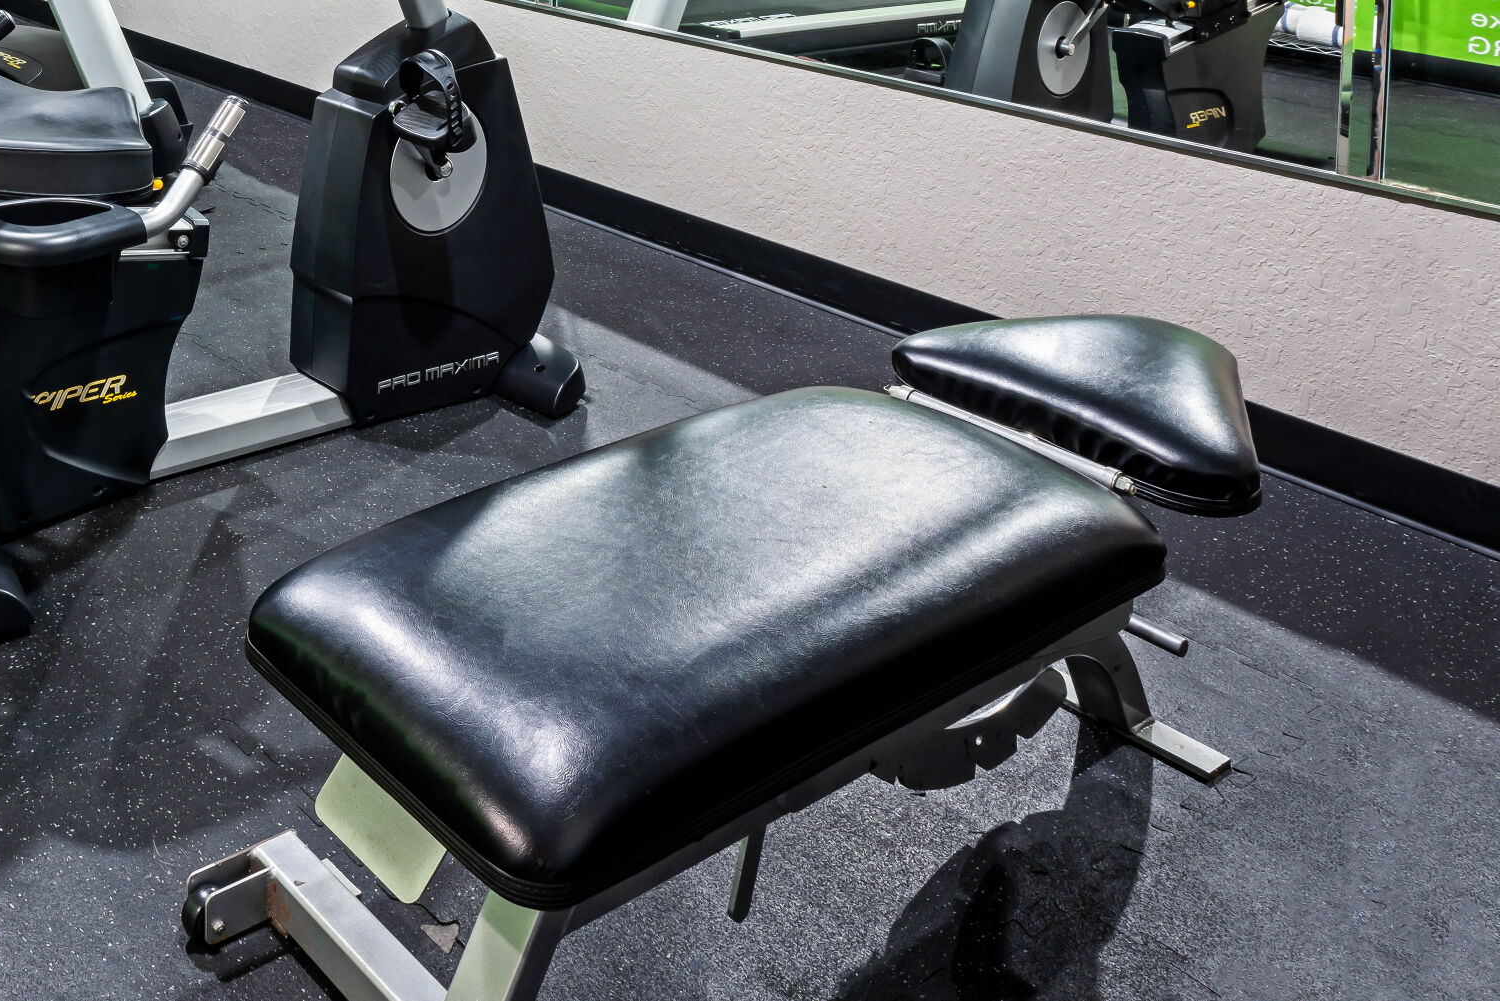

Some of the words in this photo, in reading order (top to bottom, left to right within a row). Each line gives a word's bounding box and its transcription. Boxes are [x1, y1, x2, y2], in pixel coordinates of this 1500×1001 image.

[32, 374, 126, 411] VIPER
[102, 390, 138, 405] Series
[377, 371, 420, 395] PRO
[425, 351, 499, 382] MAXIMA
